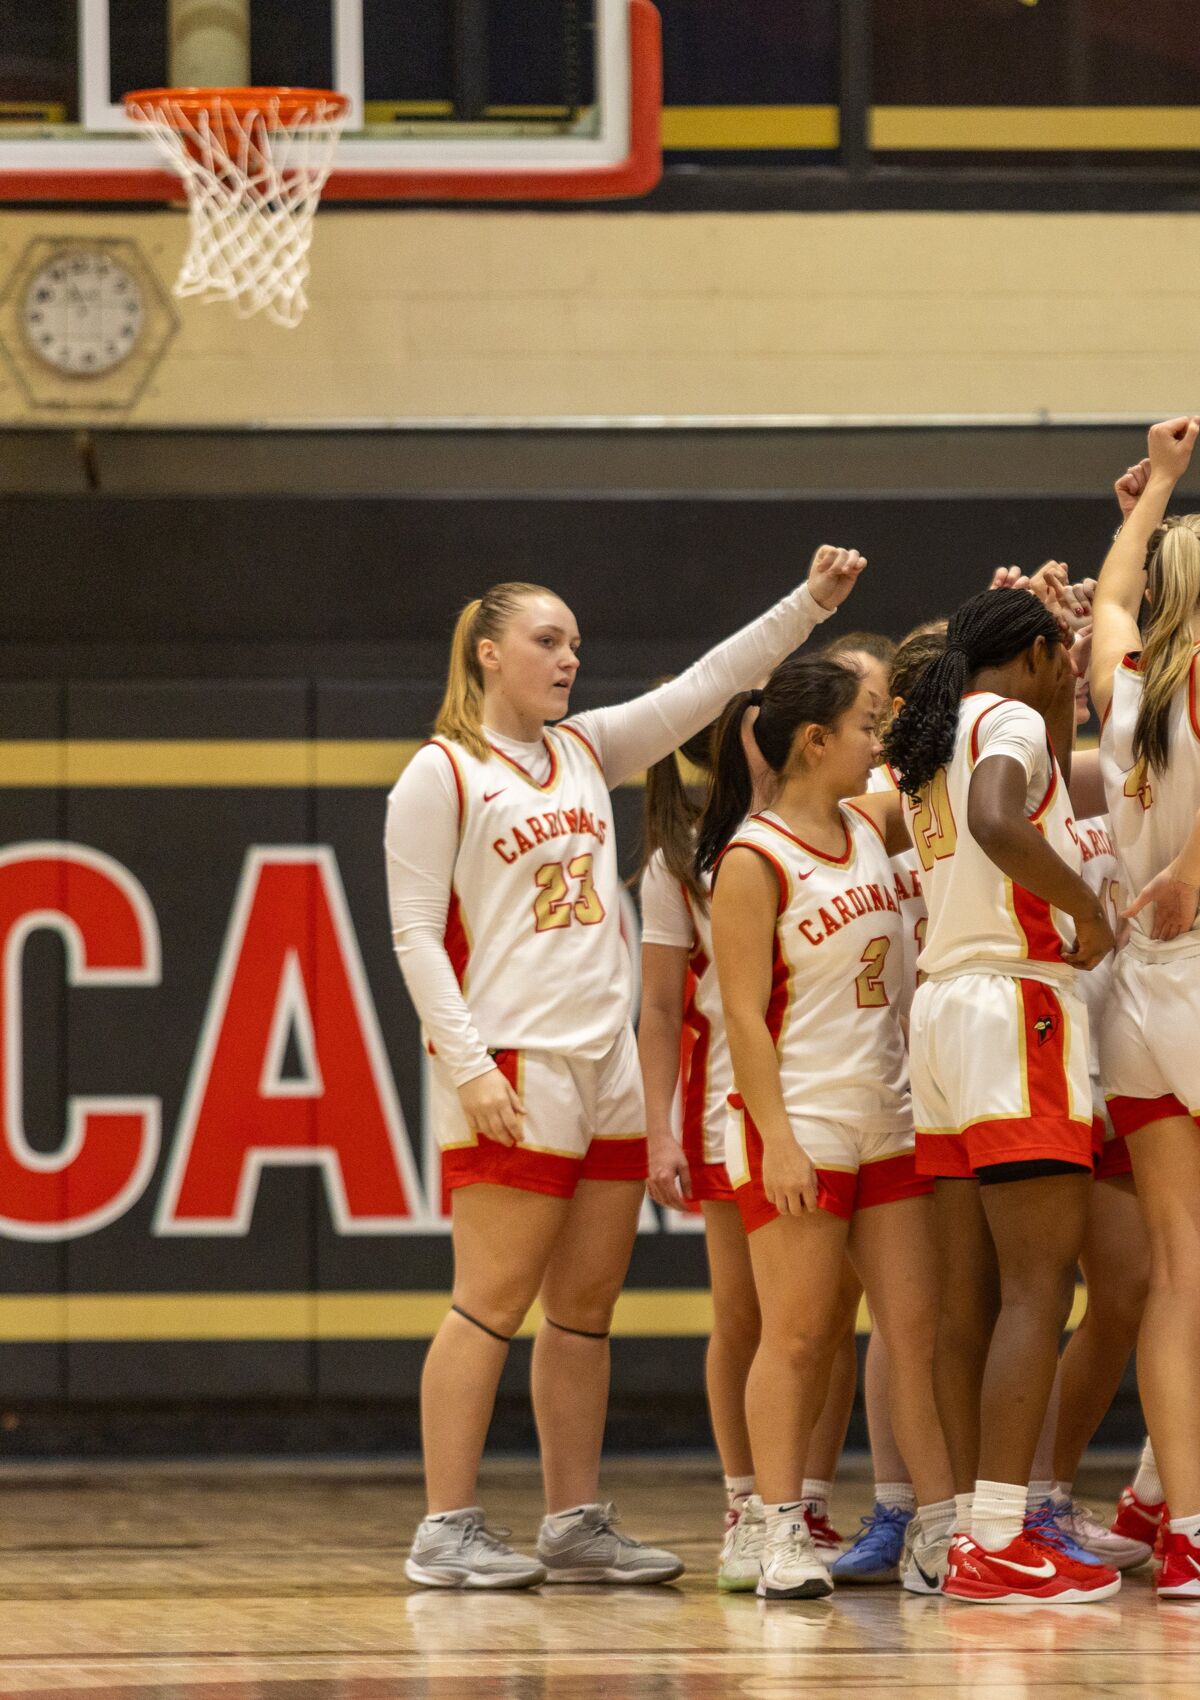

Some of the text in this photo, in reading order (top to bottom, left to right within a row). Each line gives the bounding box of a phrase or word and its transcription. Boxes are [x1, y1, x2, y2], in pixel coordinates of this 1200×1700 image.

[493, 807, 607, 865] CARDINALS
[908, 765, 958, 872] 20
[533, 852, 606, 933] 23
[855, 935, 891, 1009] 2
